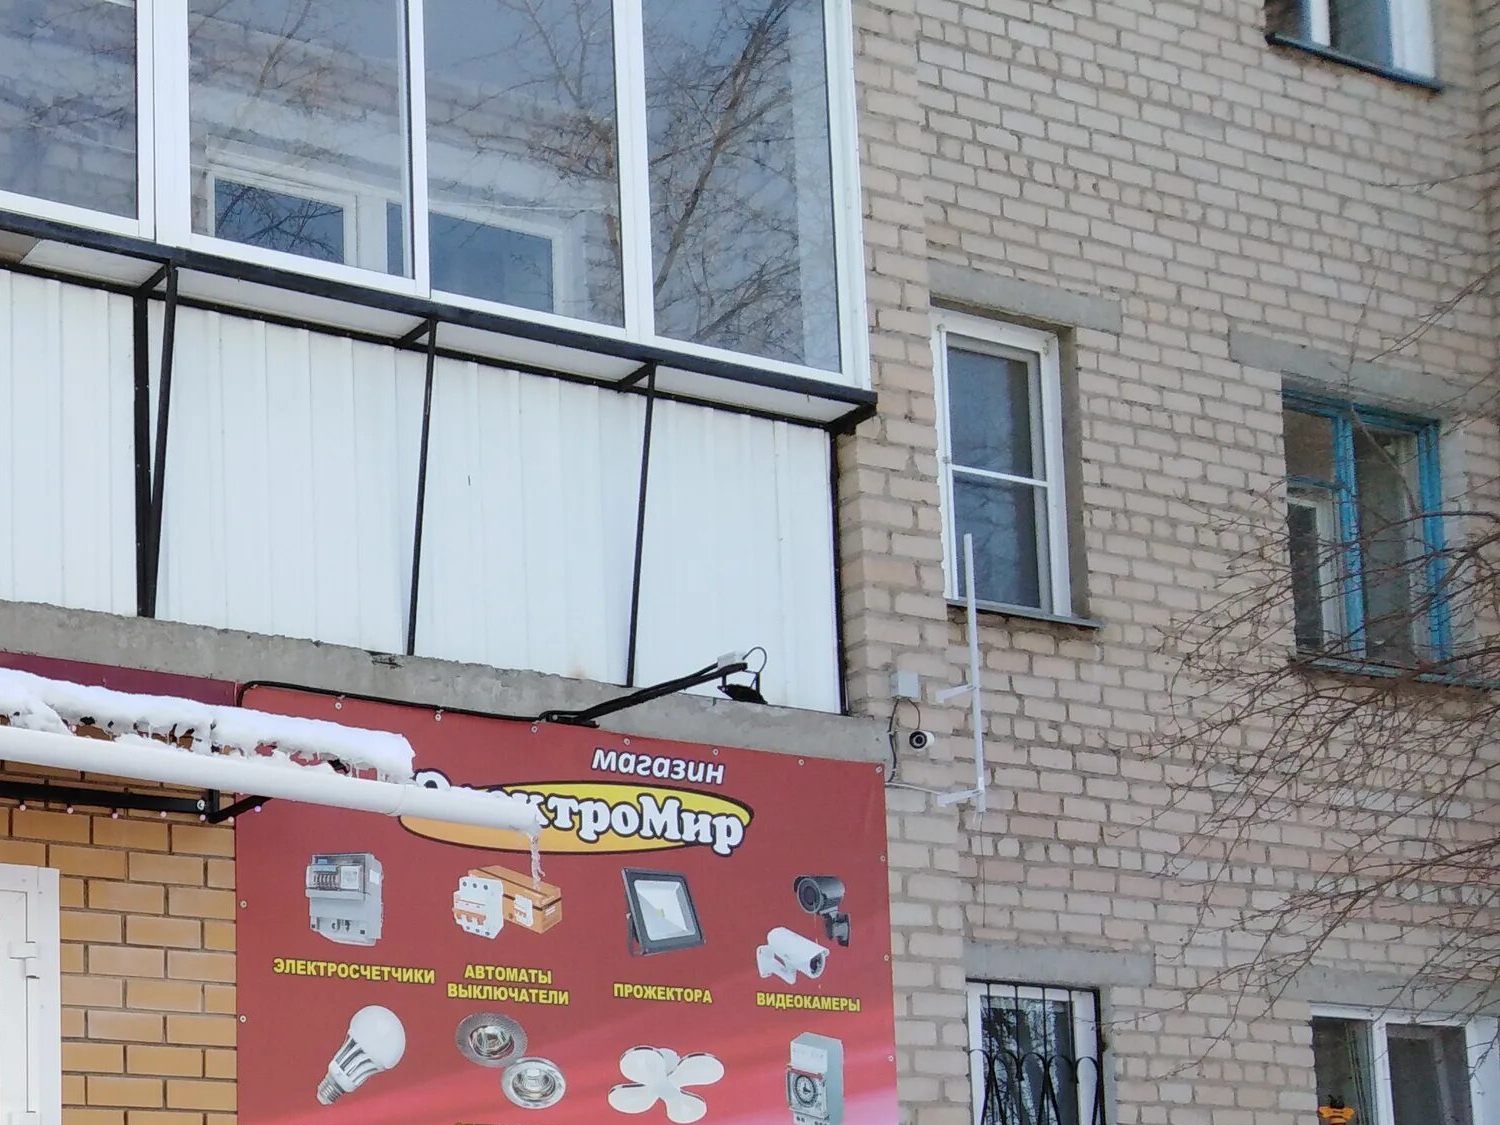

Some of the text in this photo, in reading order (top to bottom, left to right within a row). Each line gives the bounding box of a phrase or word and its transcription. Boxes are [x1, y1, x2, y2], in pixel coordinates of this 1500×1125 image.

[591, 748, 725, 785] магазин
[413, 771, 745, 856] ктроМир
[273, 957, 436, 984] ЭЛЕКТРОСЧЕТЧИКИ
[464, 964, 552, 984] АВТОМАТЫ
[447, 983, 569, 1005] ВЫКЛЮЧАТЕЛИ
[613, 983, 712, 1004] ПРОЖЕКТОРА
[756, 992, 861, 1012] ВИДЕОКАМЕРЫ
